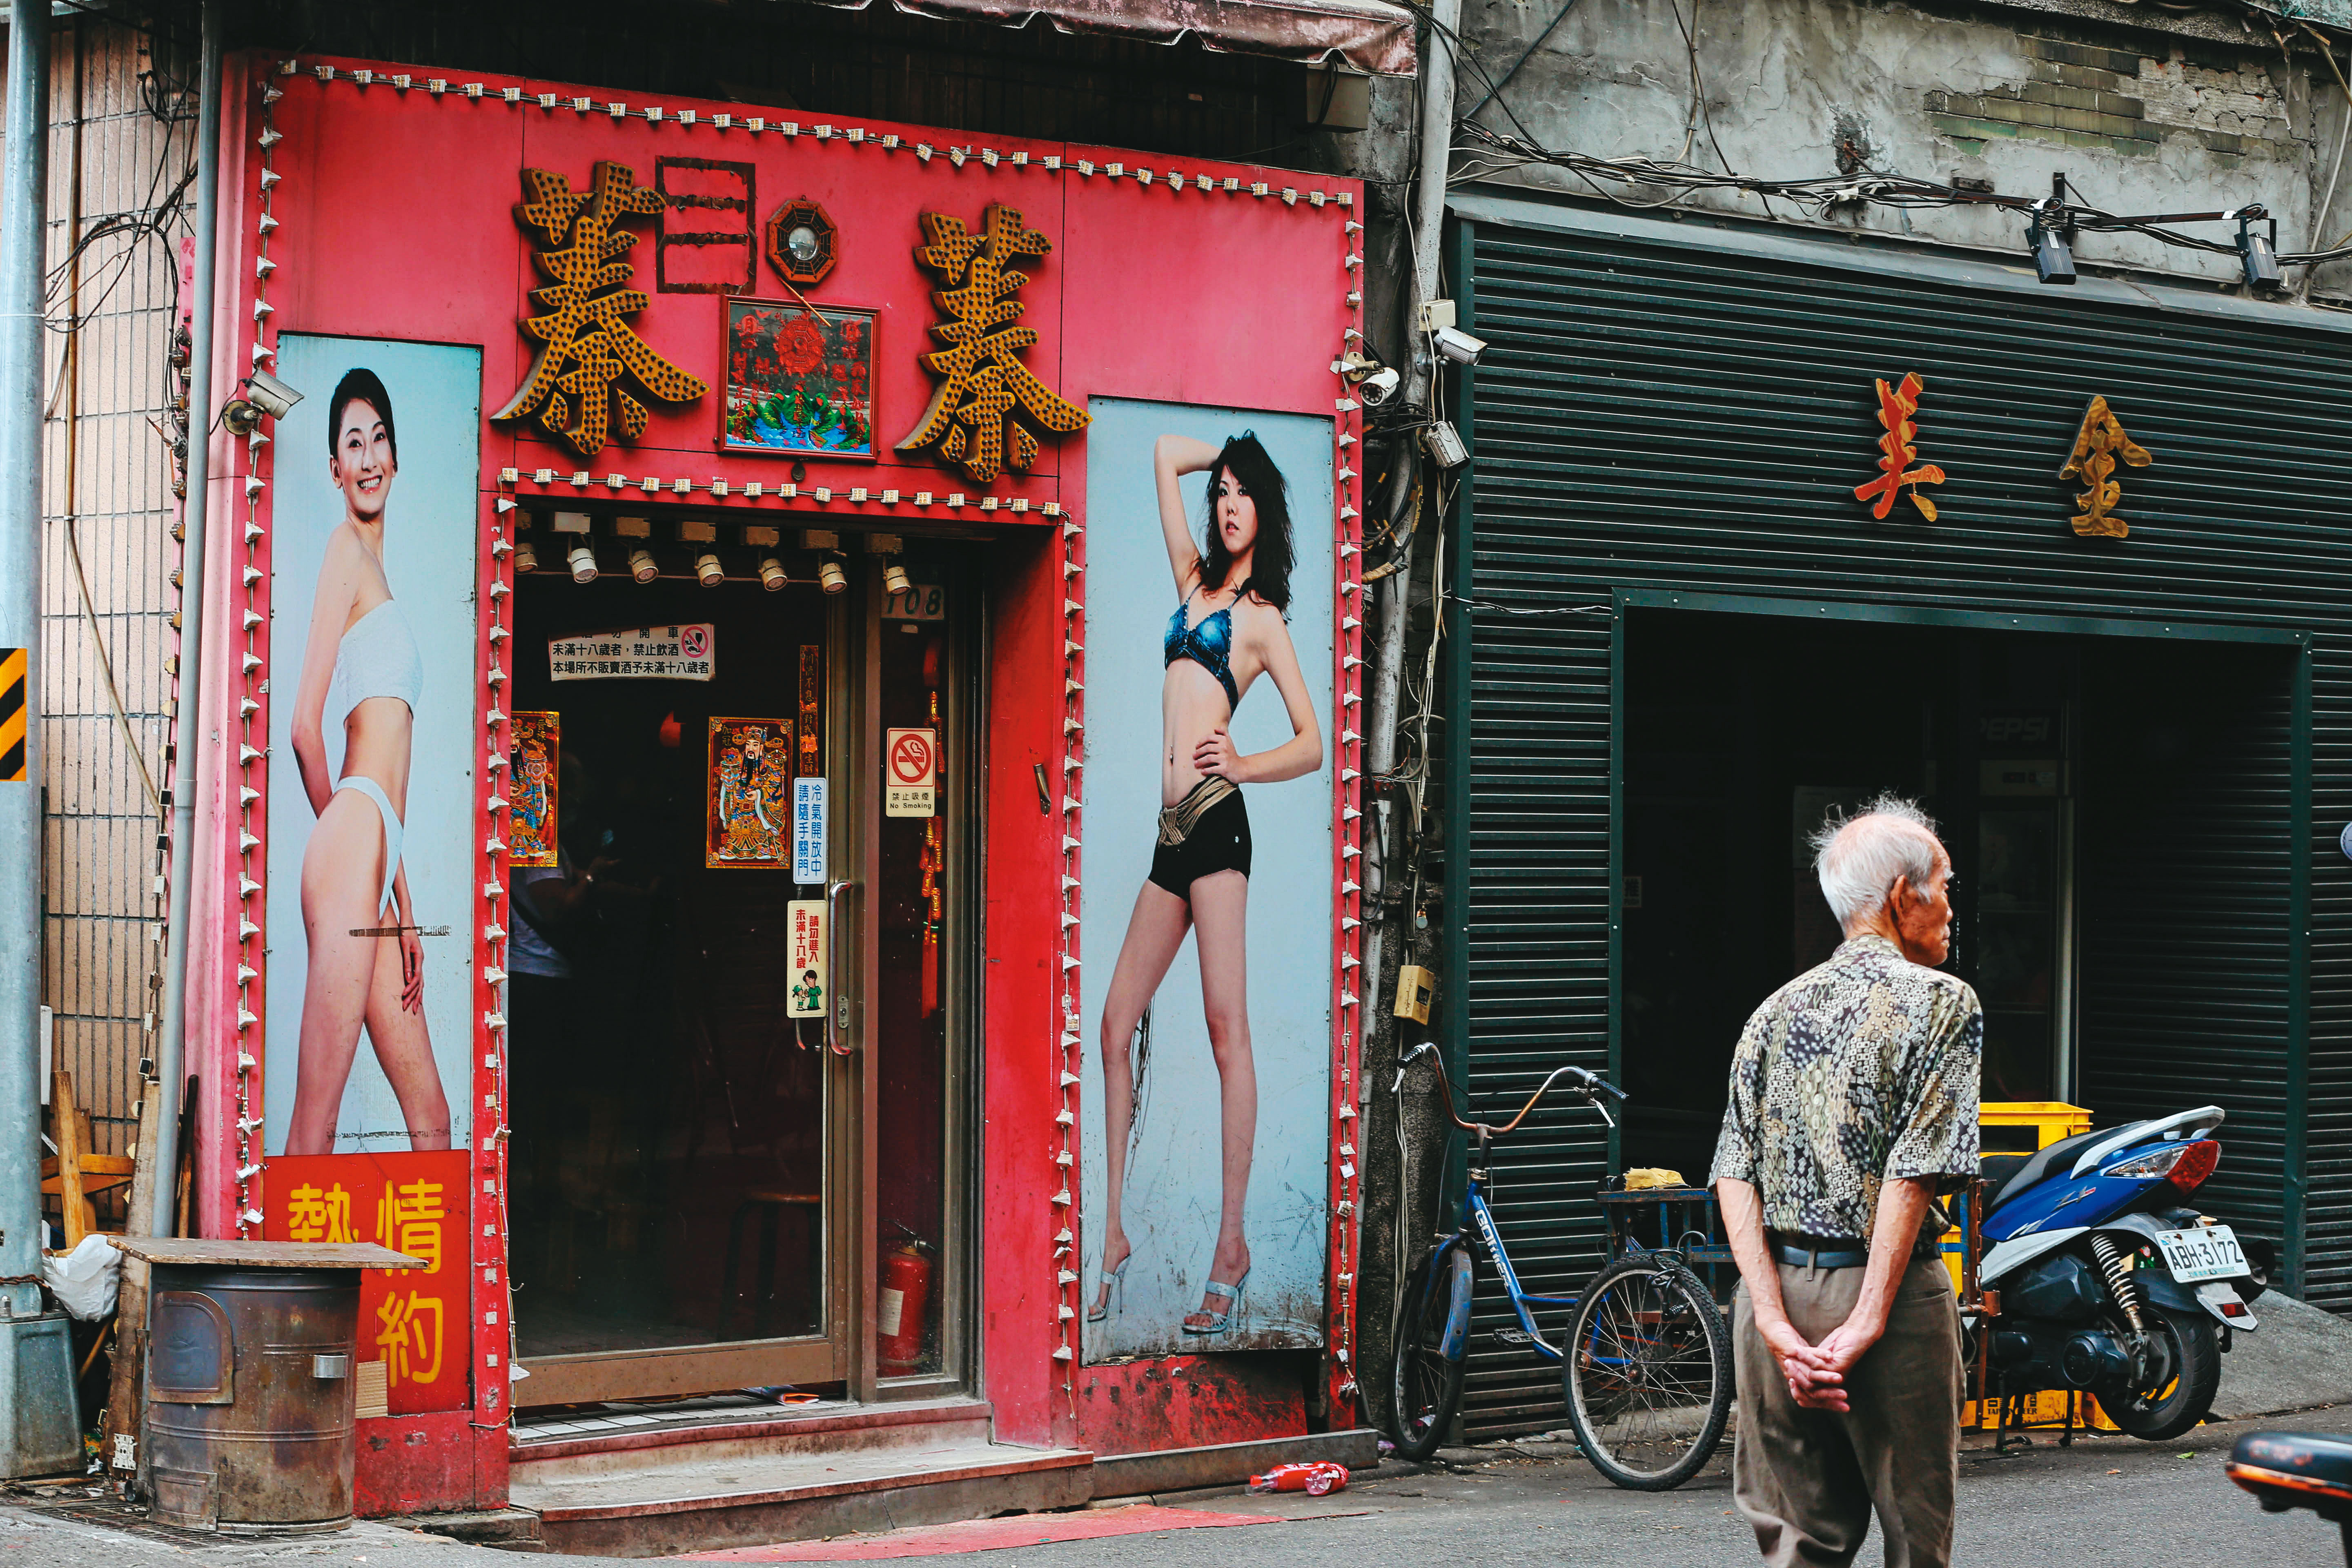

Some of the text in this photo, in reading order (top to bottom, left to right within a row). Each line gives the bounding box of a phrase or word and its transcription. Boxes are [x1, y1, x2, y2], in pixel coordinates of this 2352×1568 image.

[887, 588, 941, 616] 108
[552, 661, 709, 674] 本場所不販賣酒予未滿十八歲者
[892, 793, 929, 801] 禁止吸煙
[798, 784, 809, 876] 請隨手關門
[811, 784, 822, 876] 冷氣開放中
[796, 909, 806, 969] 未滿十八歲
[809, 915, 819, 963] 請勿進入
[288, 1178, 444, 1277] 熱情
[2167, 1241, 2244, 1270] ABH-3172
